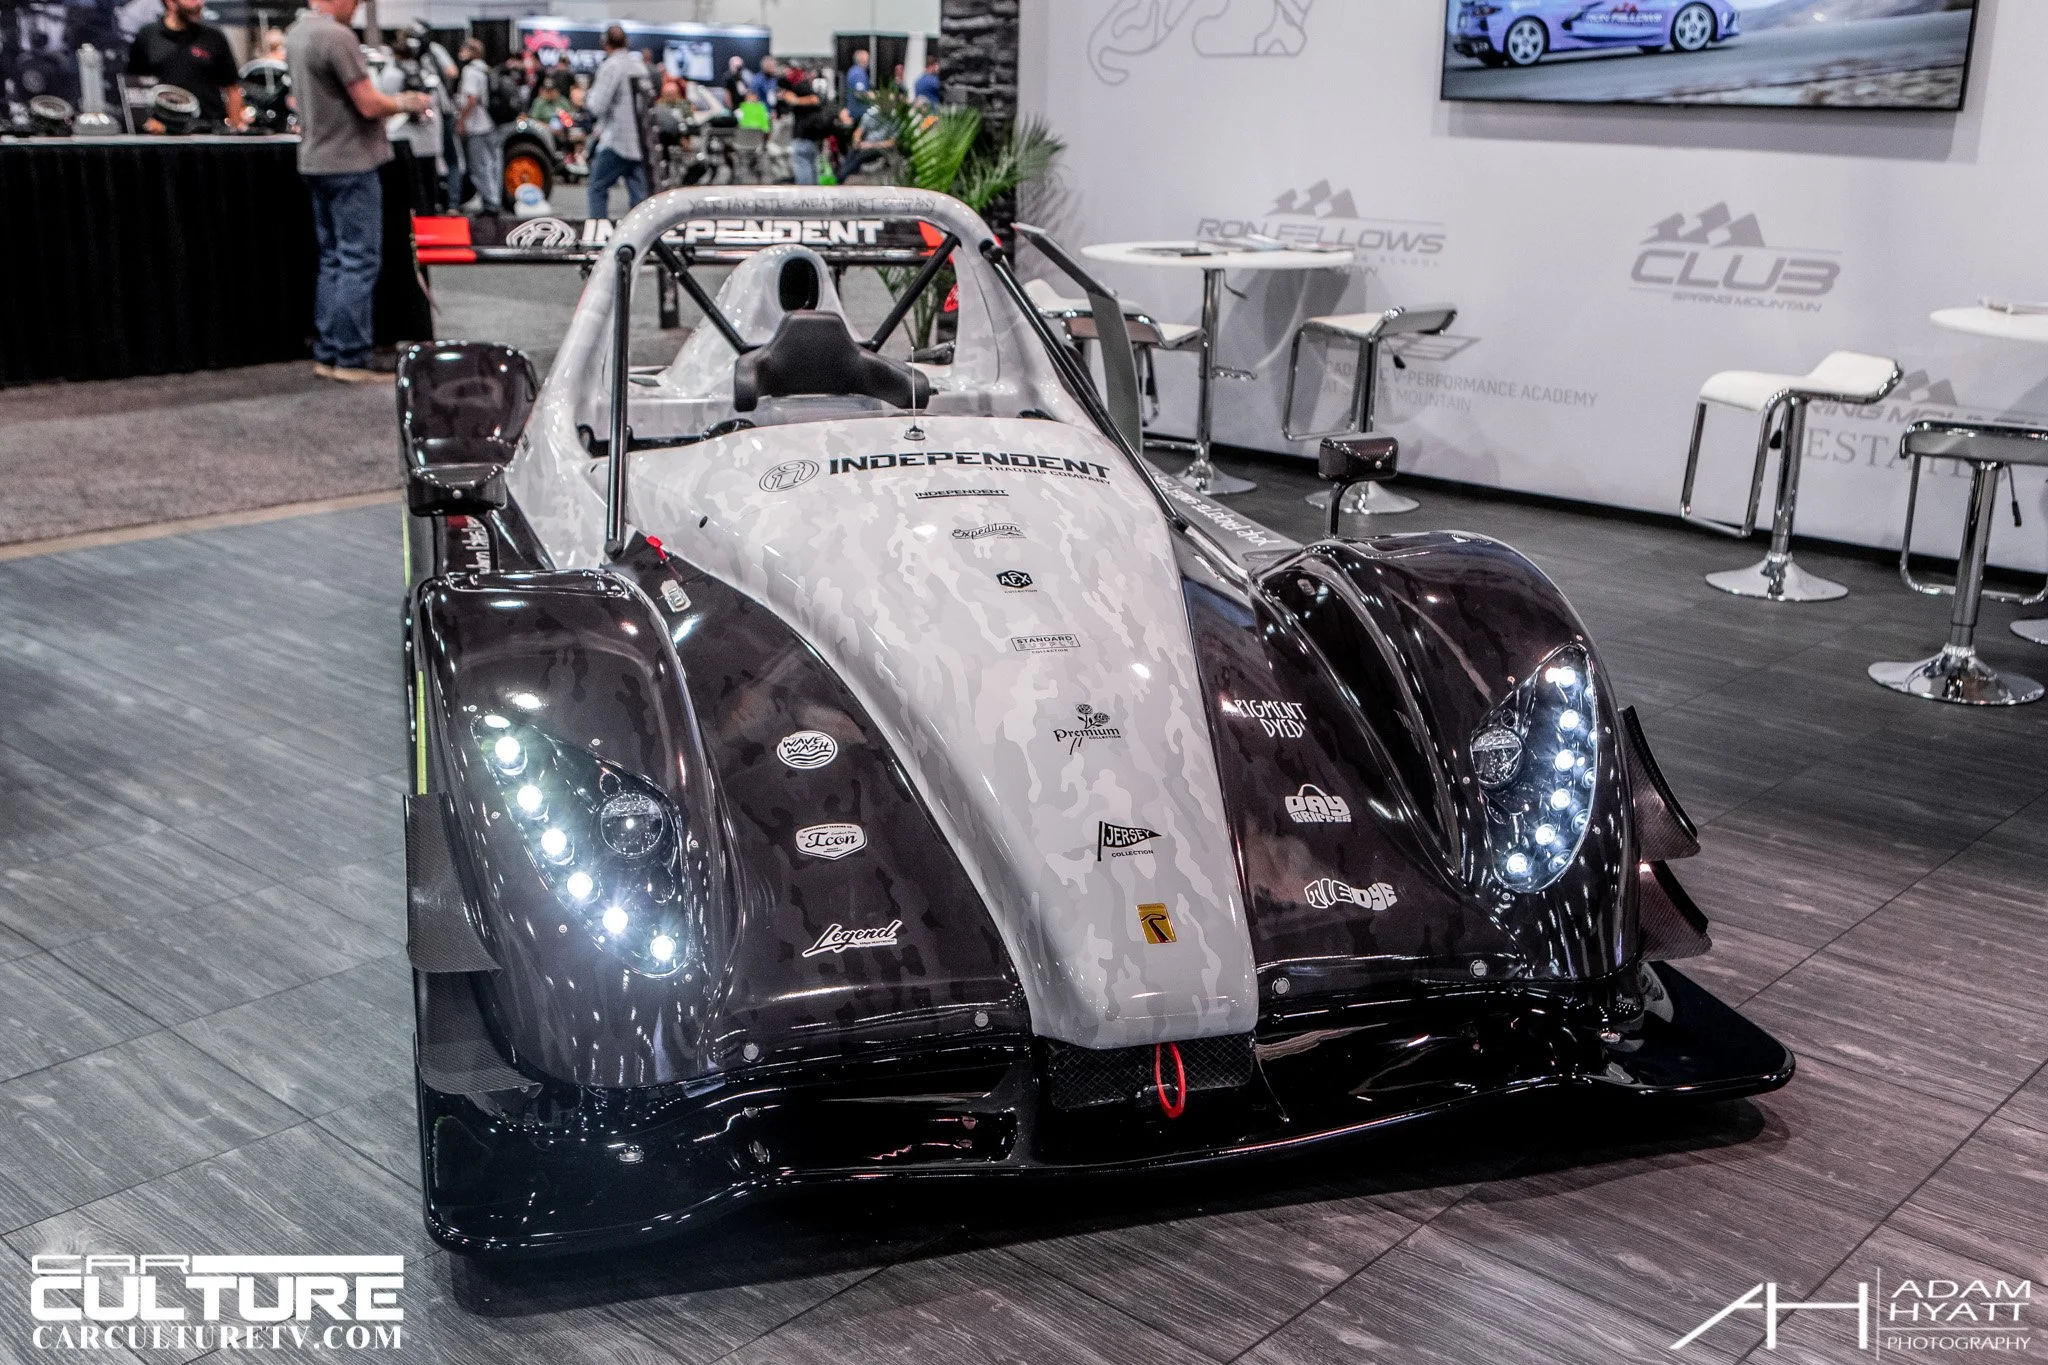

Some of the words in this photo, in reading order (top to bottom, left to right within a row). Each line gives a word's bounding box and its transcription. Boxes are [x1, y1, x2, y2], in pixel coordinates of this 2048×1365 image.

[791, 196, 876, 211] SWEATSHIRT
[881, 196, 936, 212] COMPANY
[579, 219, 884, 245] INEPENDENT
[1275, 222, 1447, 255] FELLOWS
[1630, 248, 1842, 298] CLUB
[1521, 385, 1599, 408] ACADEMY
[829, 451, 1111, 478] INDEPENDENT
[988, 465, 1047, 475] TRADING
[1050, 470, 1112, 485] COMPANY
[914, 489, 1007, 498] INDEPENDENT
[951, 522, 1021, 540] Expedition
[1016, 635, 1073, 644] STANDARD
[1234, 699, 1308, 721] PIGMENT
[1053, 726, 1121, 742] Premium
[1259, 717, 1306, 738] DYED
[783, 735, 824, 748] WAVE
[787, 741, 831, 754] WASH
[1284, 795, 1351, 817] DAY
[1290, 812, 1352, 823] TRIPPER
[805, 831, 858, 849] Icon
[1105, 825, 1151, 847] JERSEY
[1111, 849, 1154, 858] COLLECTION
[1304, 878, 1354, 909] TIE
[1350, 882, 1398, 911] DYE
[803, 920, 901, 956] Legend
